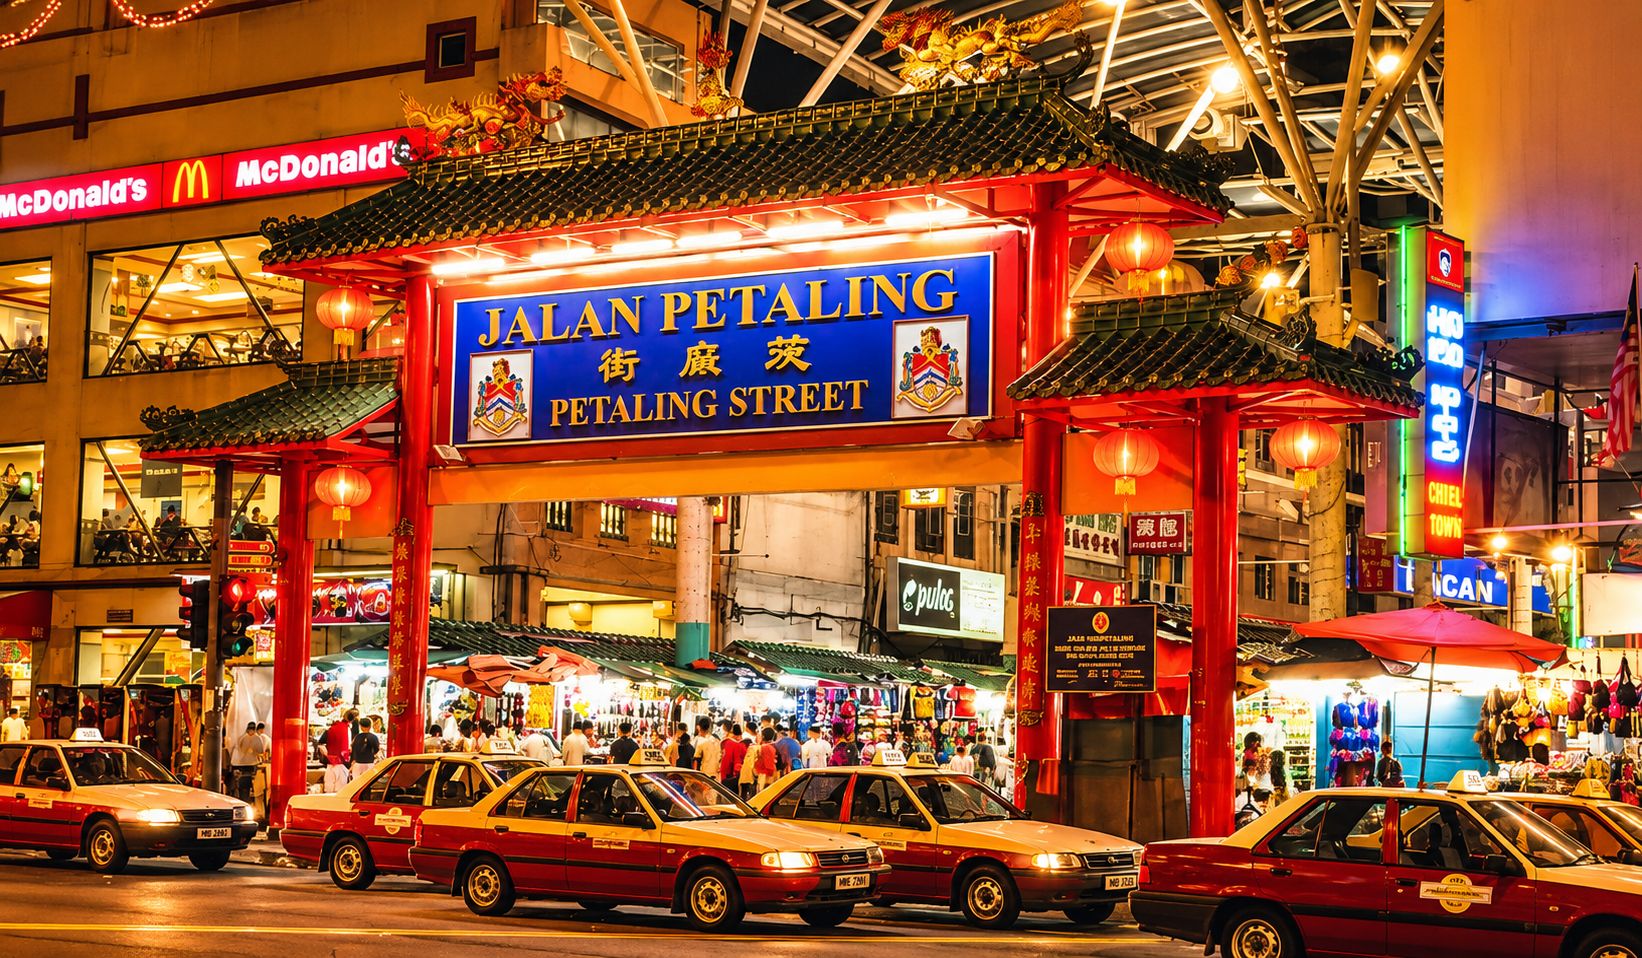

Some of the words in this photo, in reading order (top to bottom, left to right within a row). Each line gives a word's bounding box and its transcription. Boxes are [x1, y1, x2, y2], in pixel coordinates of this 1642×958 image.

[236, 140, 411, 188] McDonald's
[0, 177, 148, 218] McDonald's
[478, 295, 644, 347] JALAN
[660, 268, 958, 332] PETALING
[549, 389, 719, 427] PETALING
[729, 379, 869, 417] STREET
[1429, 513, 1463, 539] TOWN
